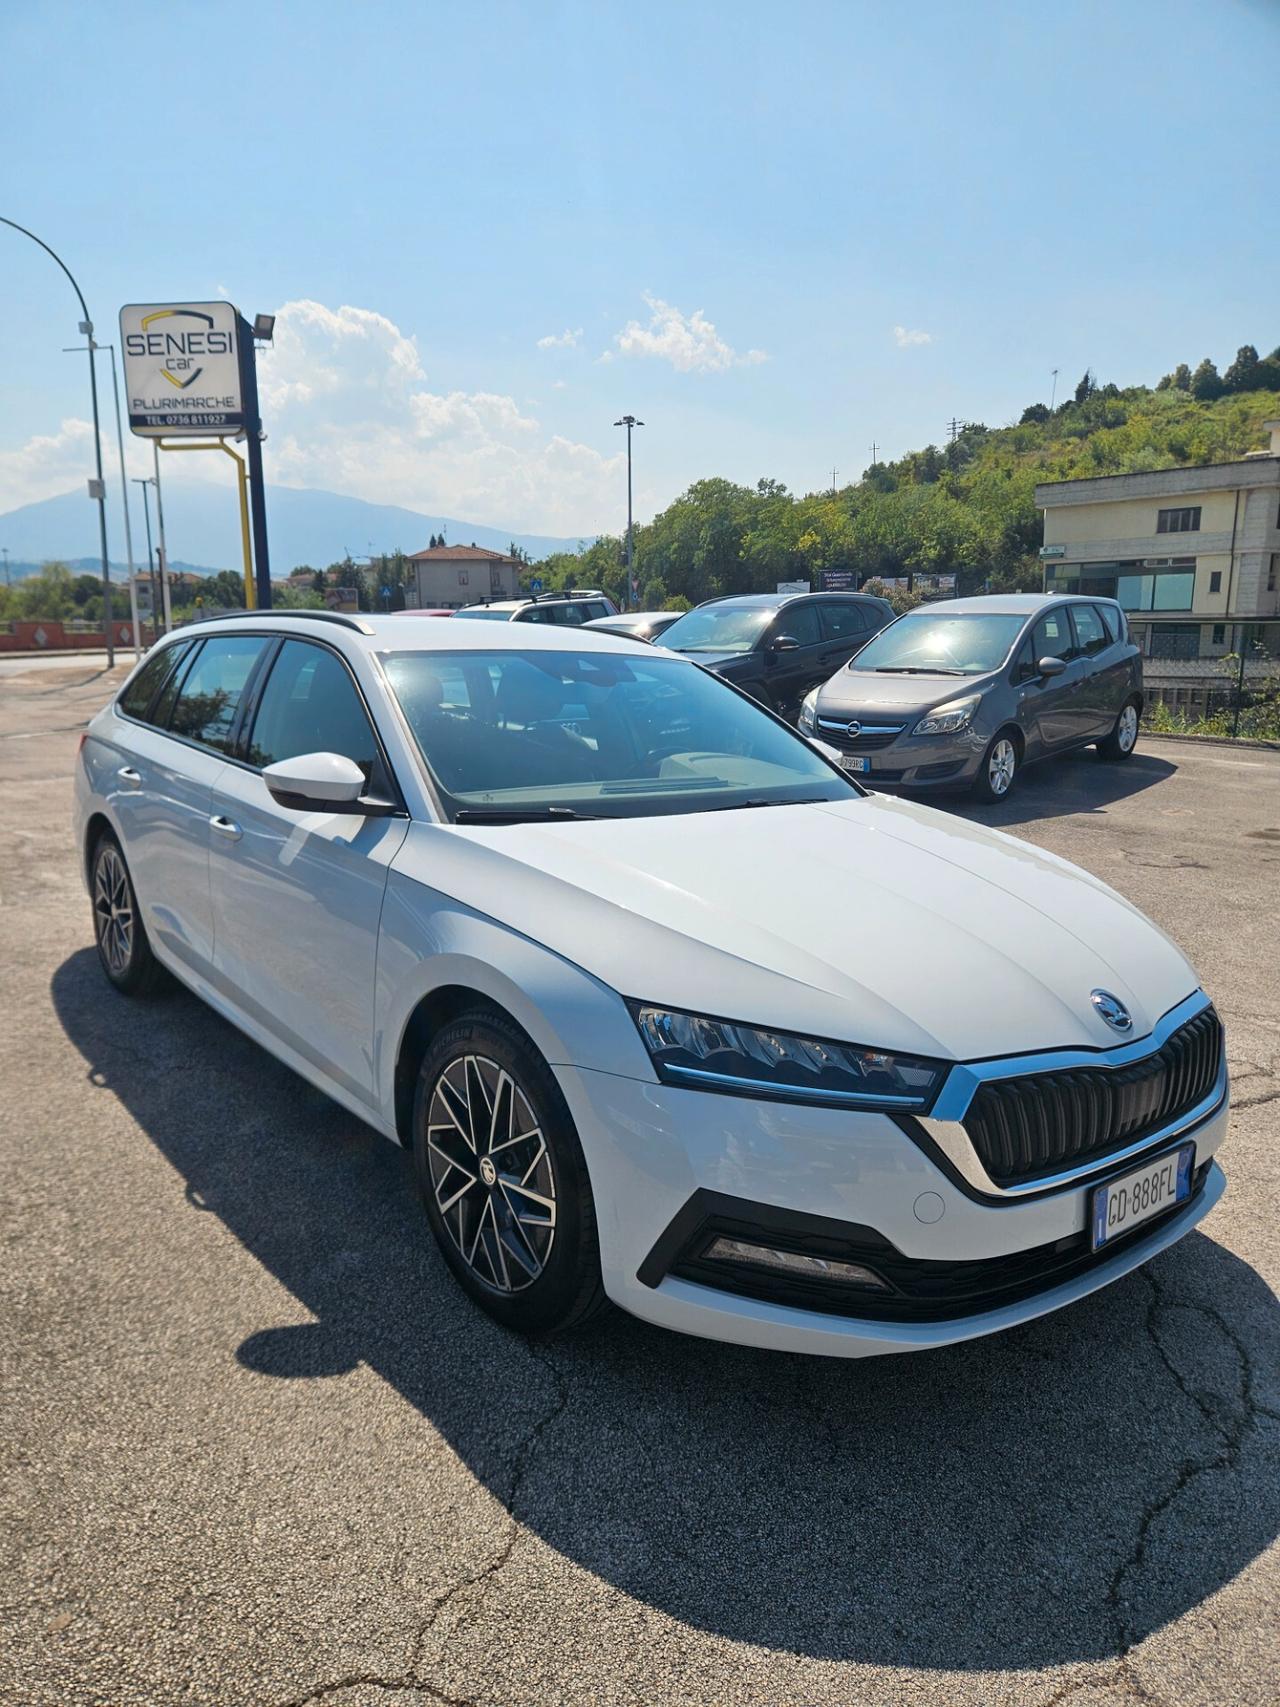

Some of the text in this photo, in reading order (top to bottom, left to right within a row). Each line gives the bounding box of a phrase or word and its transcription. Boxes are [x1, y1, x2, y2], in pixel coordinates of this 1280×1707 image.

[126, 332, 233, 357] SENESI
[165, 357, 195, 370] car
[132, 396, 235, 410] PLURIMARCHE
